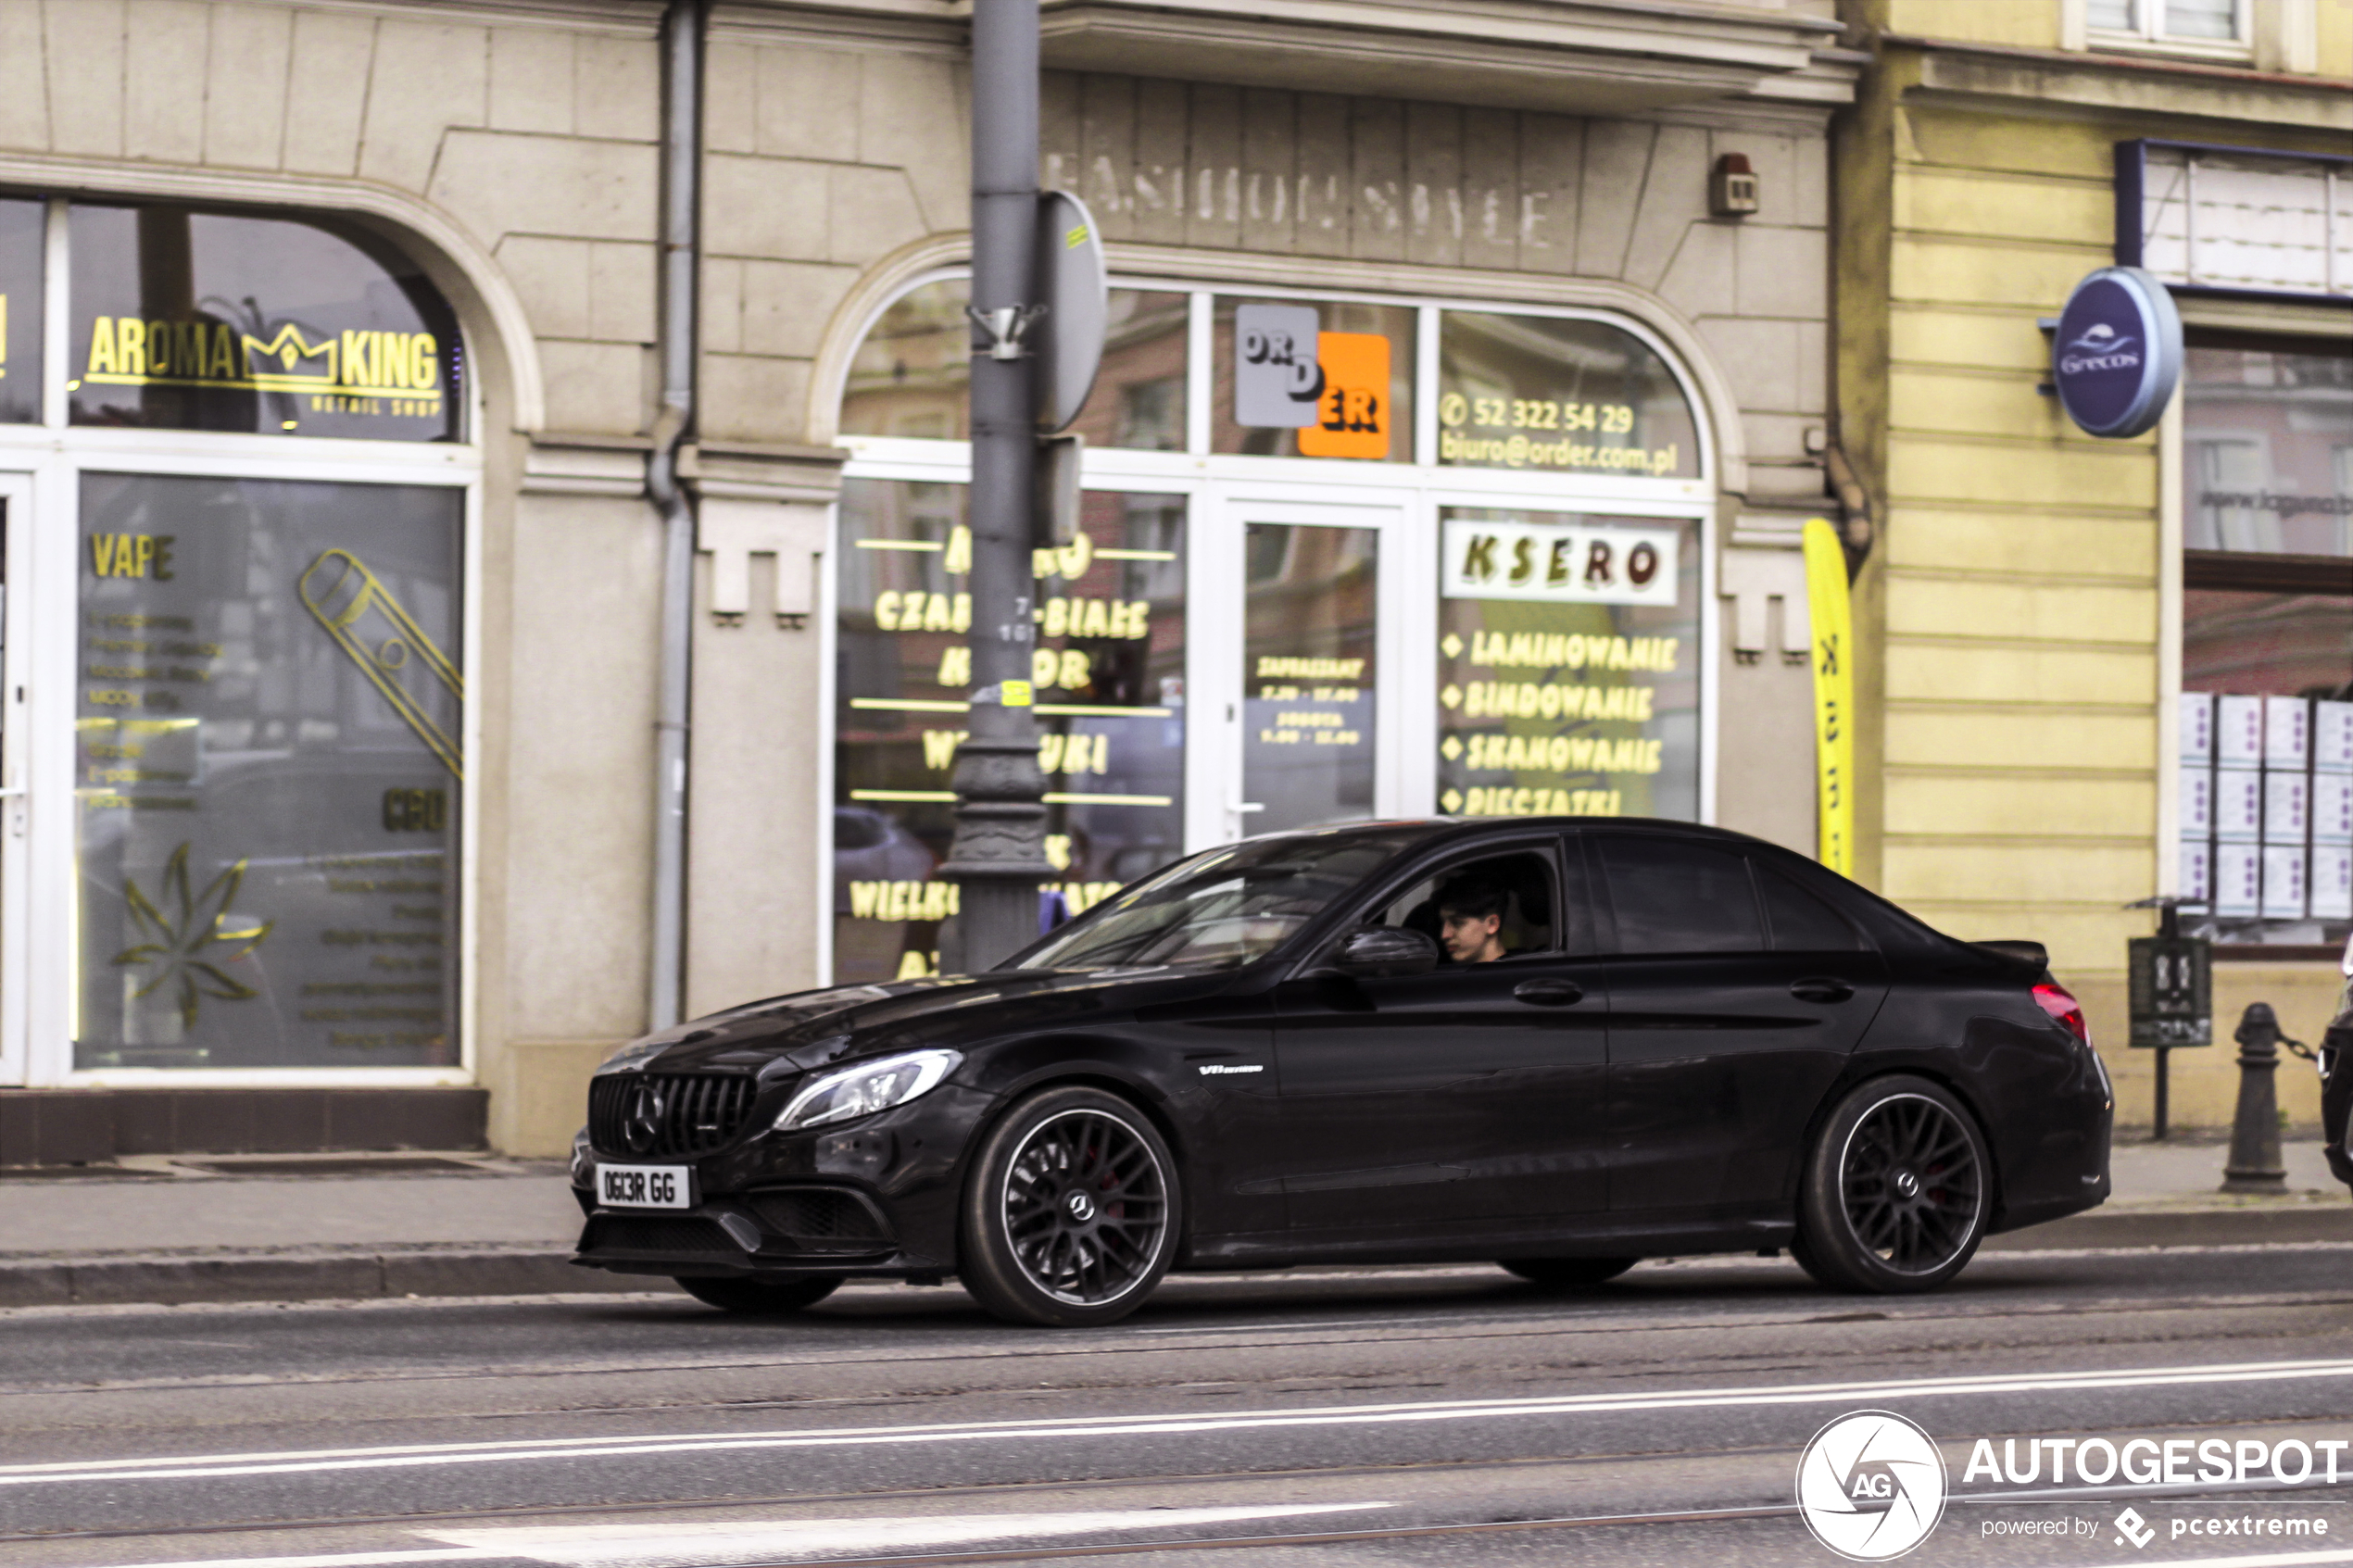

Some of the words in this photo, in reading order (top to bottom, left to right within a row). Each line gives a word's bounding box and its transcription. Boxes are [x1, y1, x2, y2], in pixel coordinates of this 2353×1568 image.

[88, 316, 235, 378] AROMA
[342, 329, 438, 389] KING
[1474, 397, 1506, 426] 52
[1511, 399, 1559, 430] 322
[1564, 403, 1596, 431] 54
[1601, 406, 1633, 433] 29
[1441, 431, 1678, 475] biuro@order.com.pl
[89, 533, 175, 581] VAPE
[1462, 533, 1663, 591] KSERO
[1471, 631, 1679, 671] LAMINOWANIE
[1465, 681, 1655, 721] BINDOWANIE
[1466, 734, 1664, 774] SKANOWANIE
[650, 1172, 674, 1203] GG
